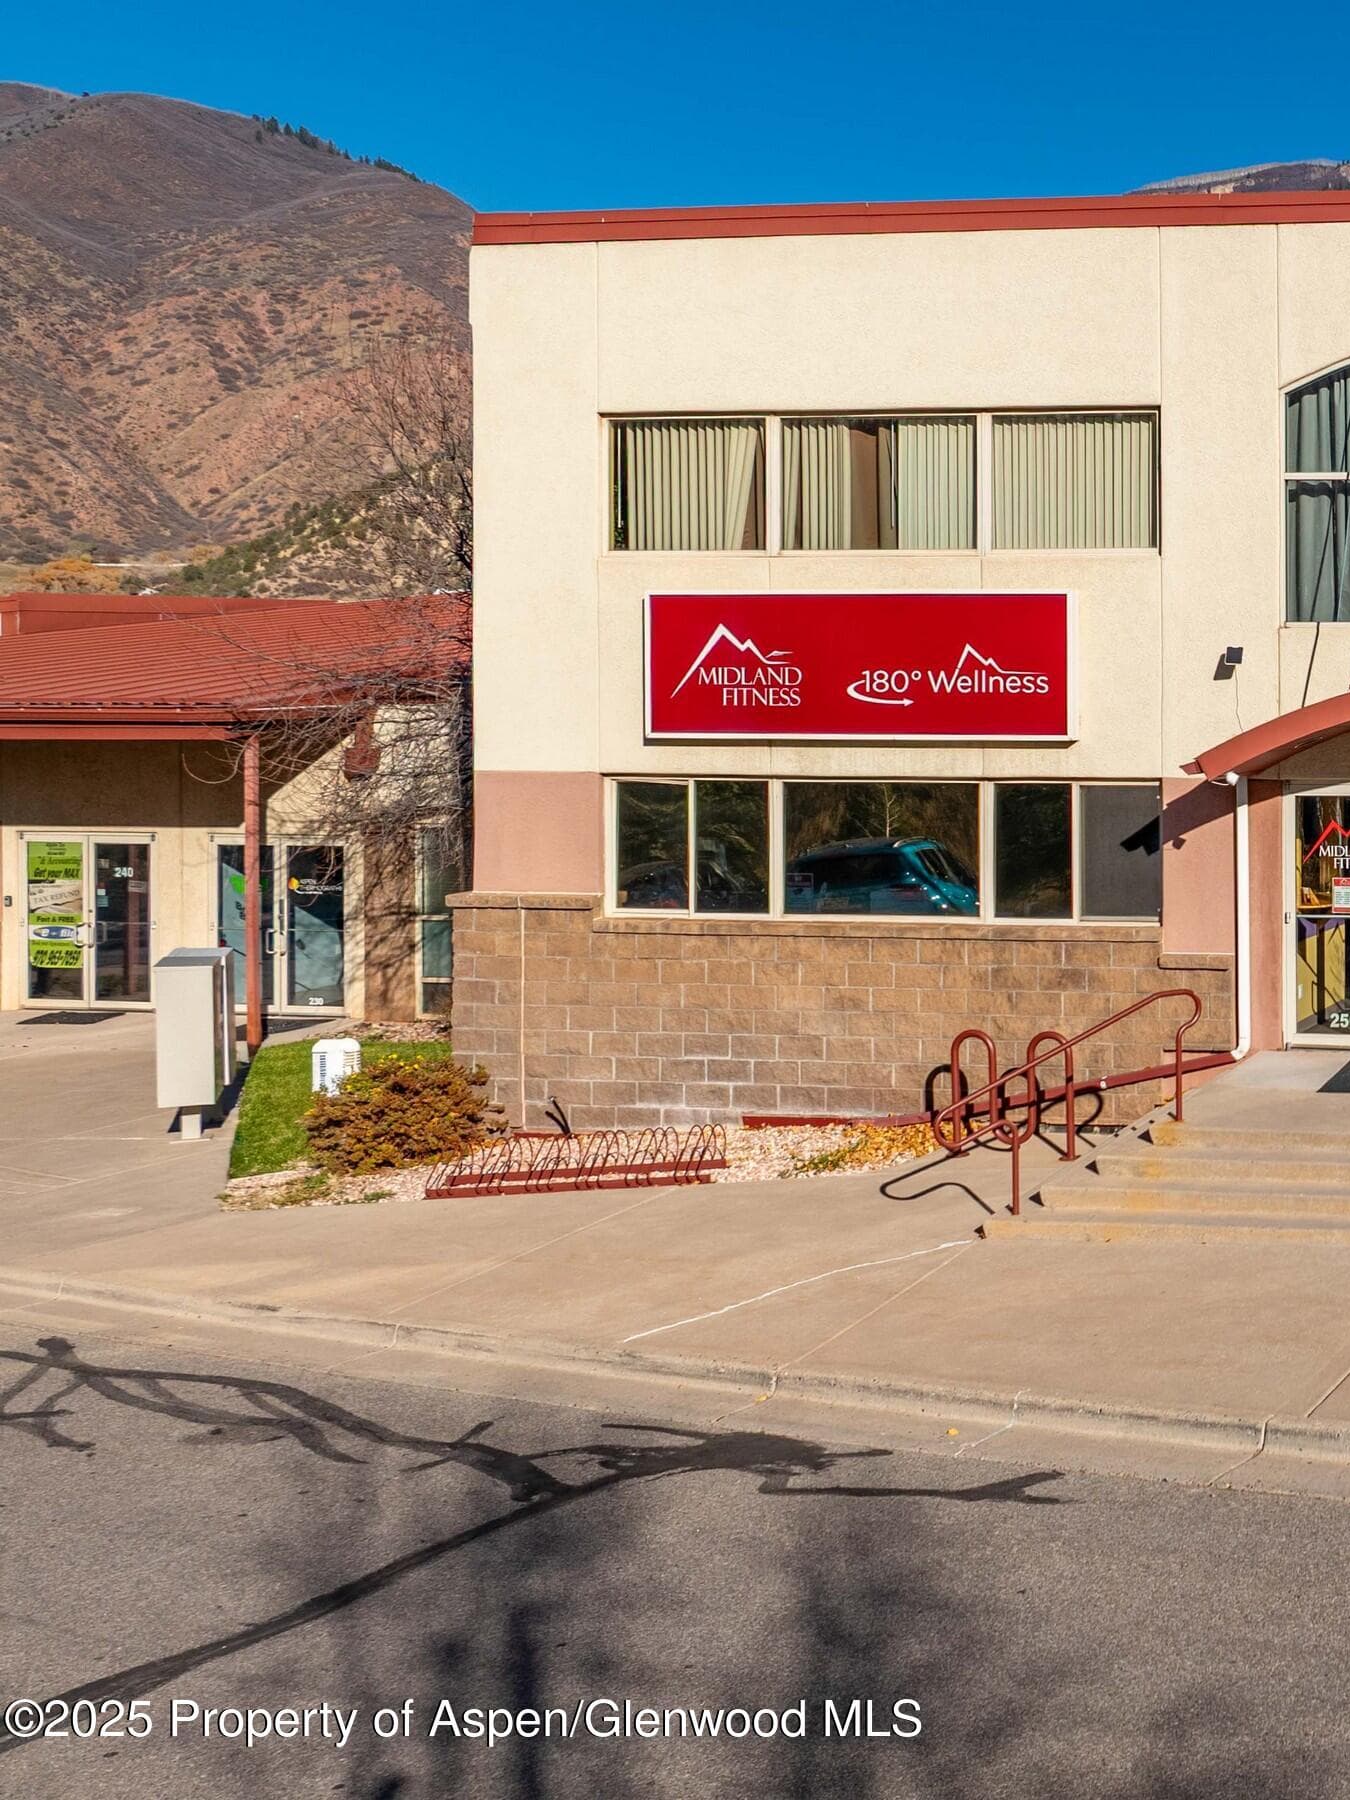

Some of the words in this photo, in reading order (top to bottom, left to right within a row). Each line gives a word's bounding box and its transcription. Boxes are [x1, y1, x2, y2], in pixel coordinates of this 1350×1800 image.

[698, 666, 802, 687] MIDLAND
[928, 665, 1049, 694] Wellness
[722, 689, 801, 708] FITNESS
[113, 867, 134, 878] 240
